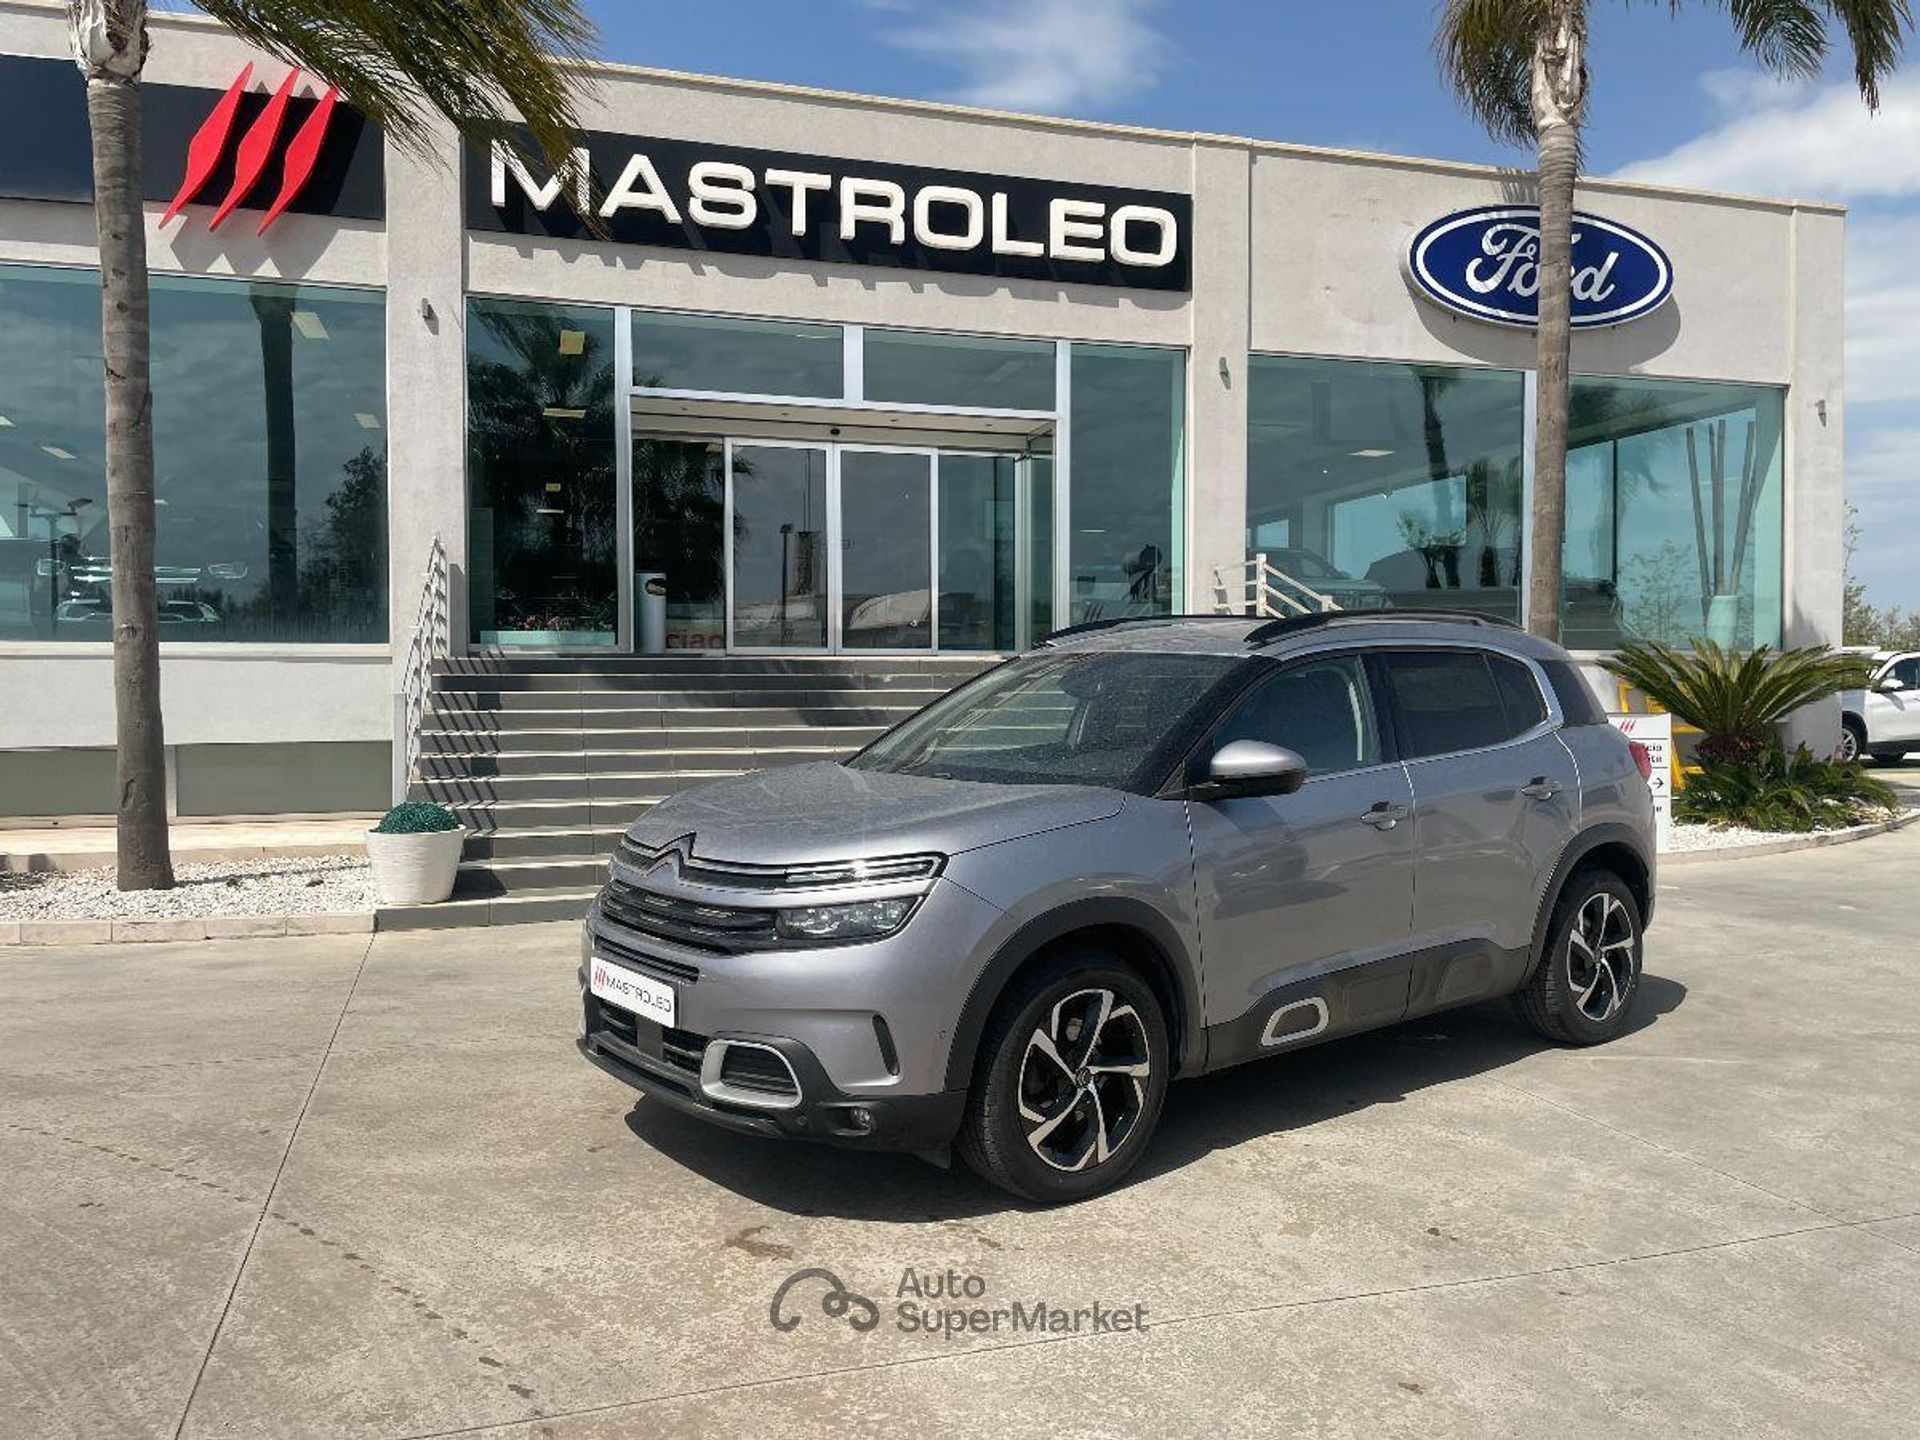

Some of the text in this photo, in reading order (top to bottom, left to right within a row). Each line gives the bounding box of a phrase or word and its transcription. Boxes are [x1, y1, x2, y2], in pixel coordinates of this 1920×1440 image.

[490, 137, 1179, 267] MASTROLEO
[1466, 223, 1619, 302] Fod
[606, 975, 672, 1012] MASTROLEO
